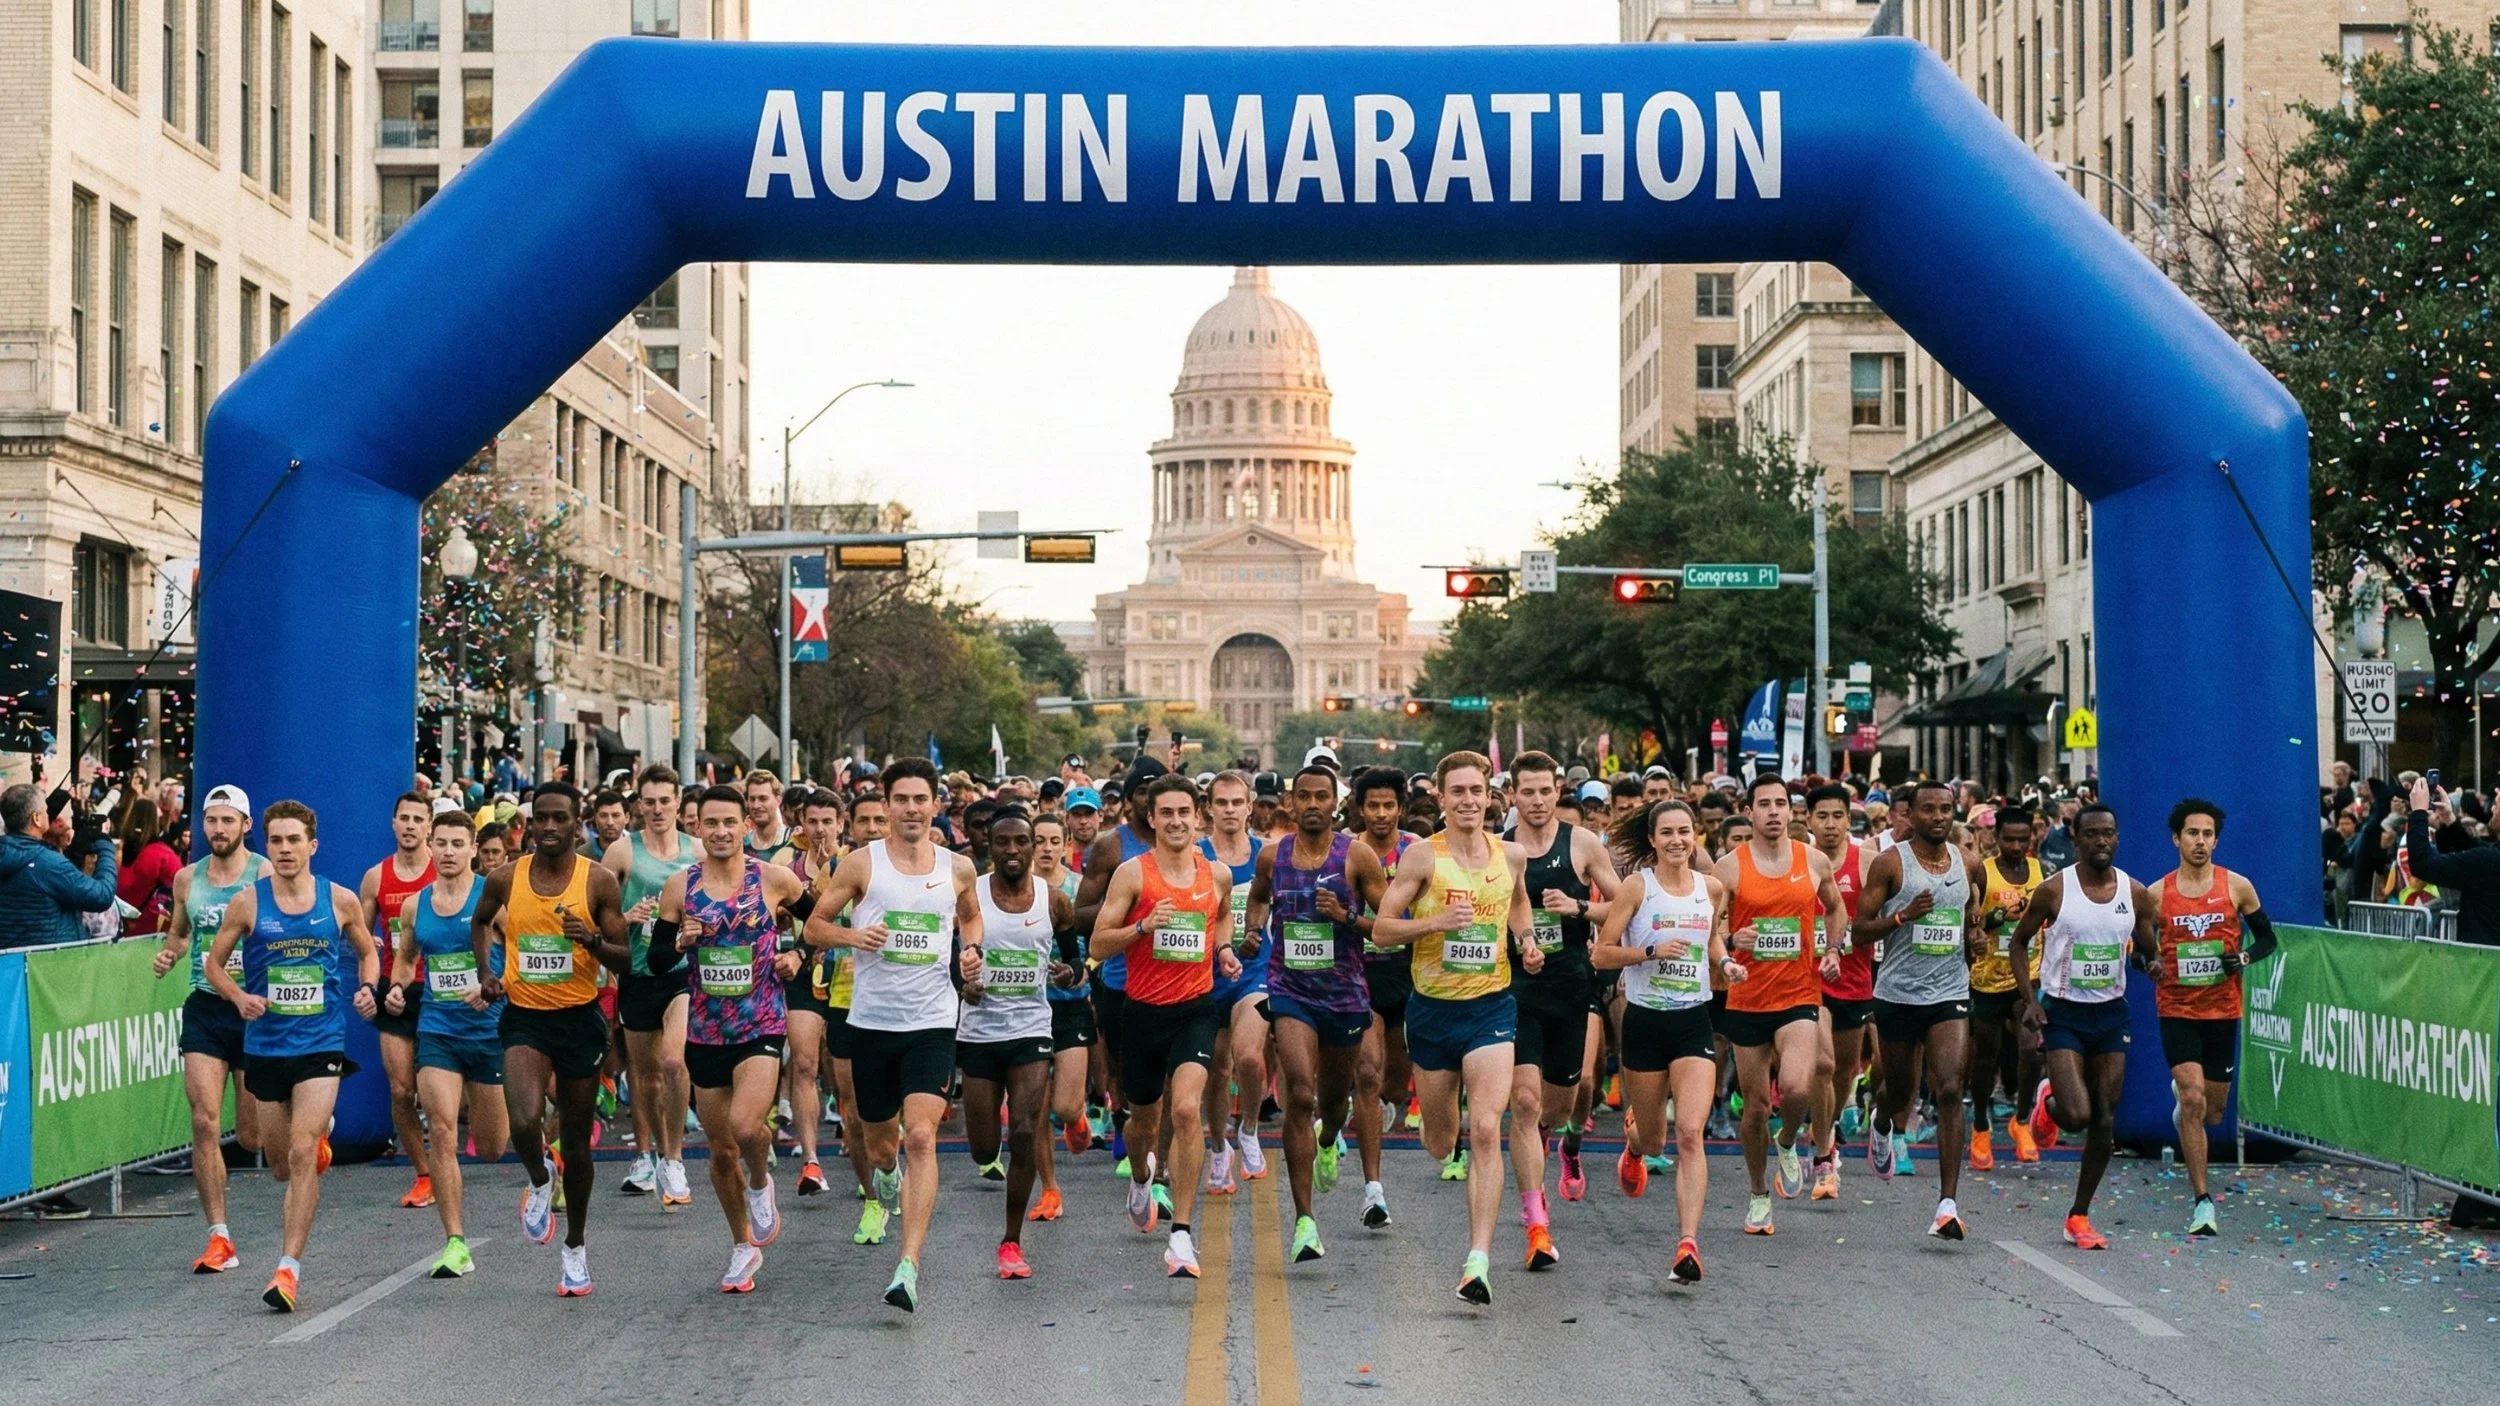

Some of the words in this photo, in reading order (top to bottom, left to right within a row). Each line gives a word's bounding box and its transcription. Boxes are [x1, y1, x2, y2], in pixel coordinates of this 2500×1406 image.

[745, 89, 1128, 202] AUSTIN
[1178, 90, 1782, 202] MARATHON
[1688, 568, 1749, 587] Congress
[2354, 679, 2386, 689] LIMIT
[2250, 1011, 2291, 1044] MARATHON
[2300, 1002, 2366, 1078] AUSTIN
[2372, 1013, 2491, 1106] MARATHON
[38, 1019, 121, 1106] AUSTIN
